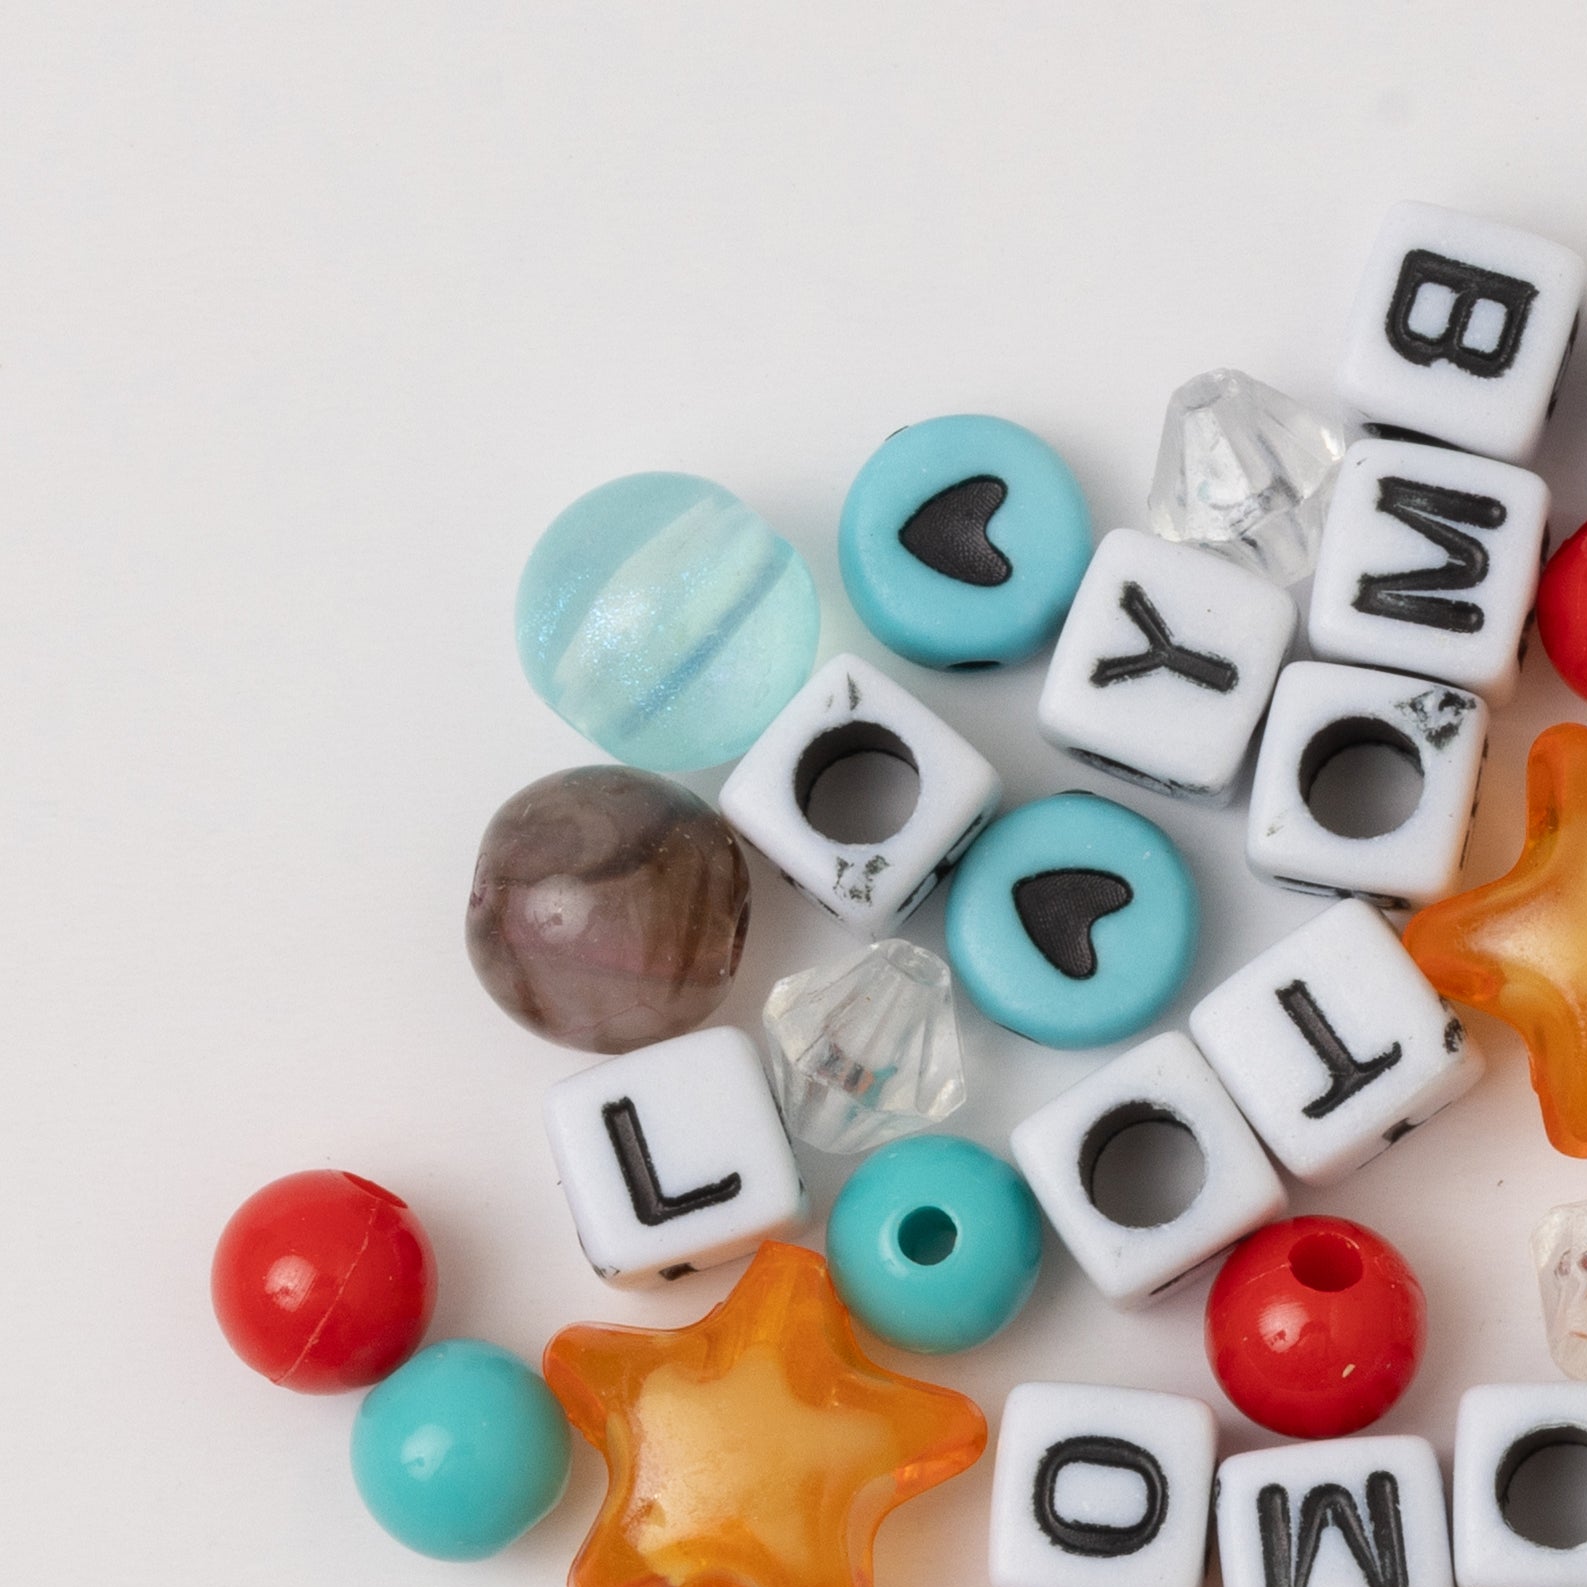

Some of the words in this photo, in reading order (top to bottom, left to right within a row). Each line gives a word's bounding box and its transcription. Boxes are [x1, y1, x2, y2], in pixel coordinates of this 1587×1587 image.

[1383, 247, 1541, 380] B
[1089, 581, 1240, 694] Y
[1274, 978, 1404, 1120] T
[600, 1095, 743, 1228] L
[1031, 1433, 1171, 1560] O
